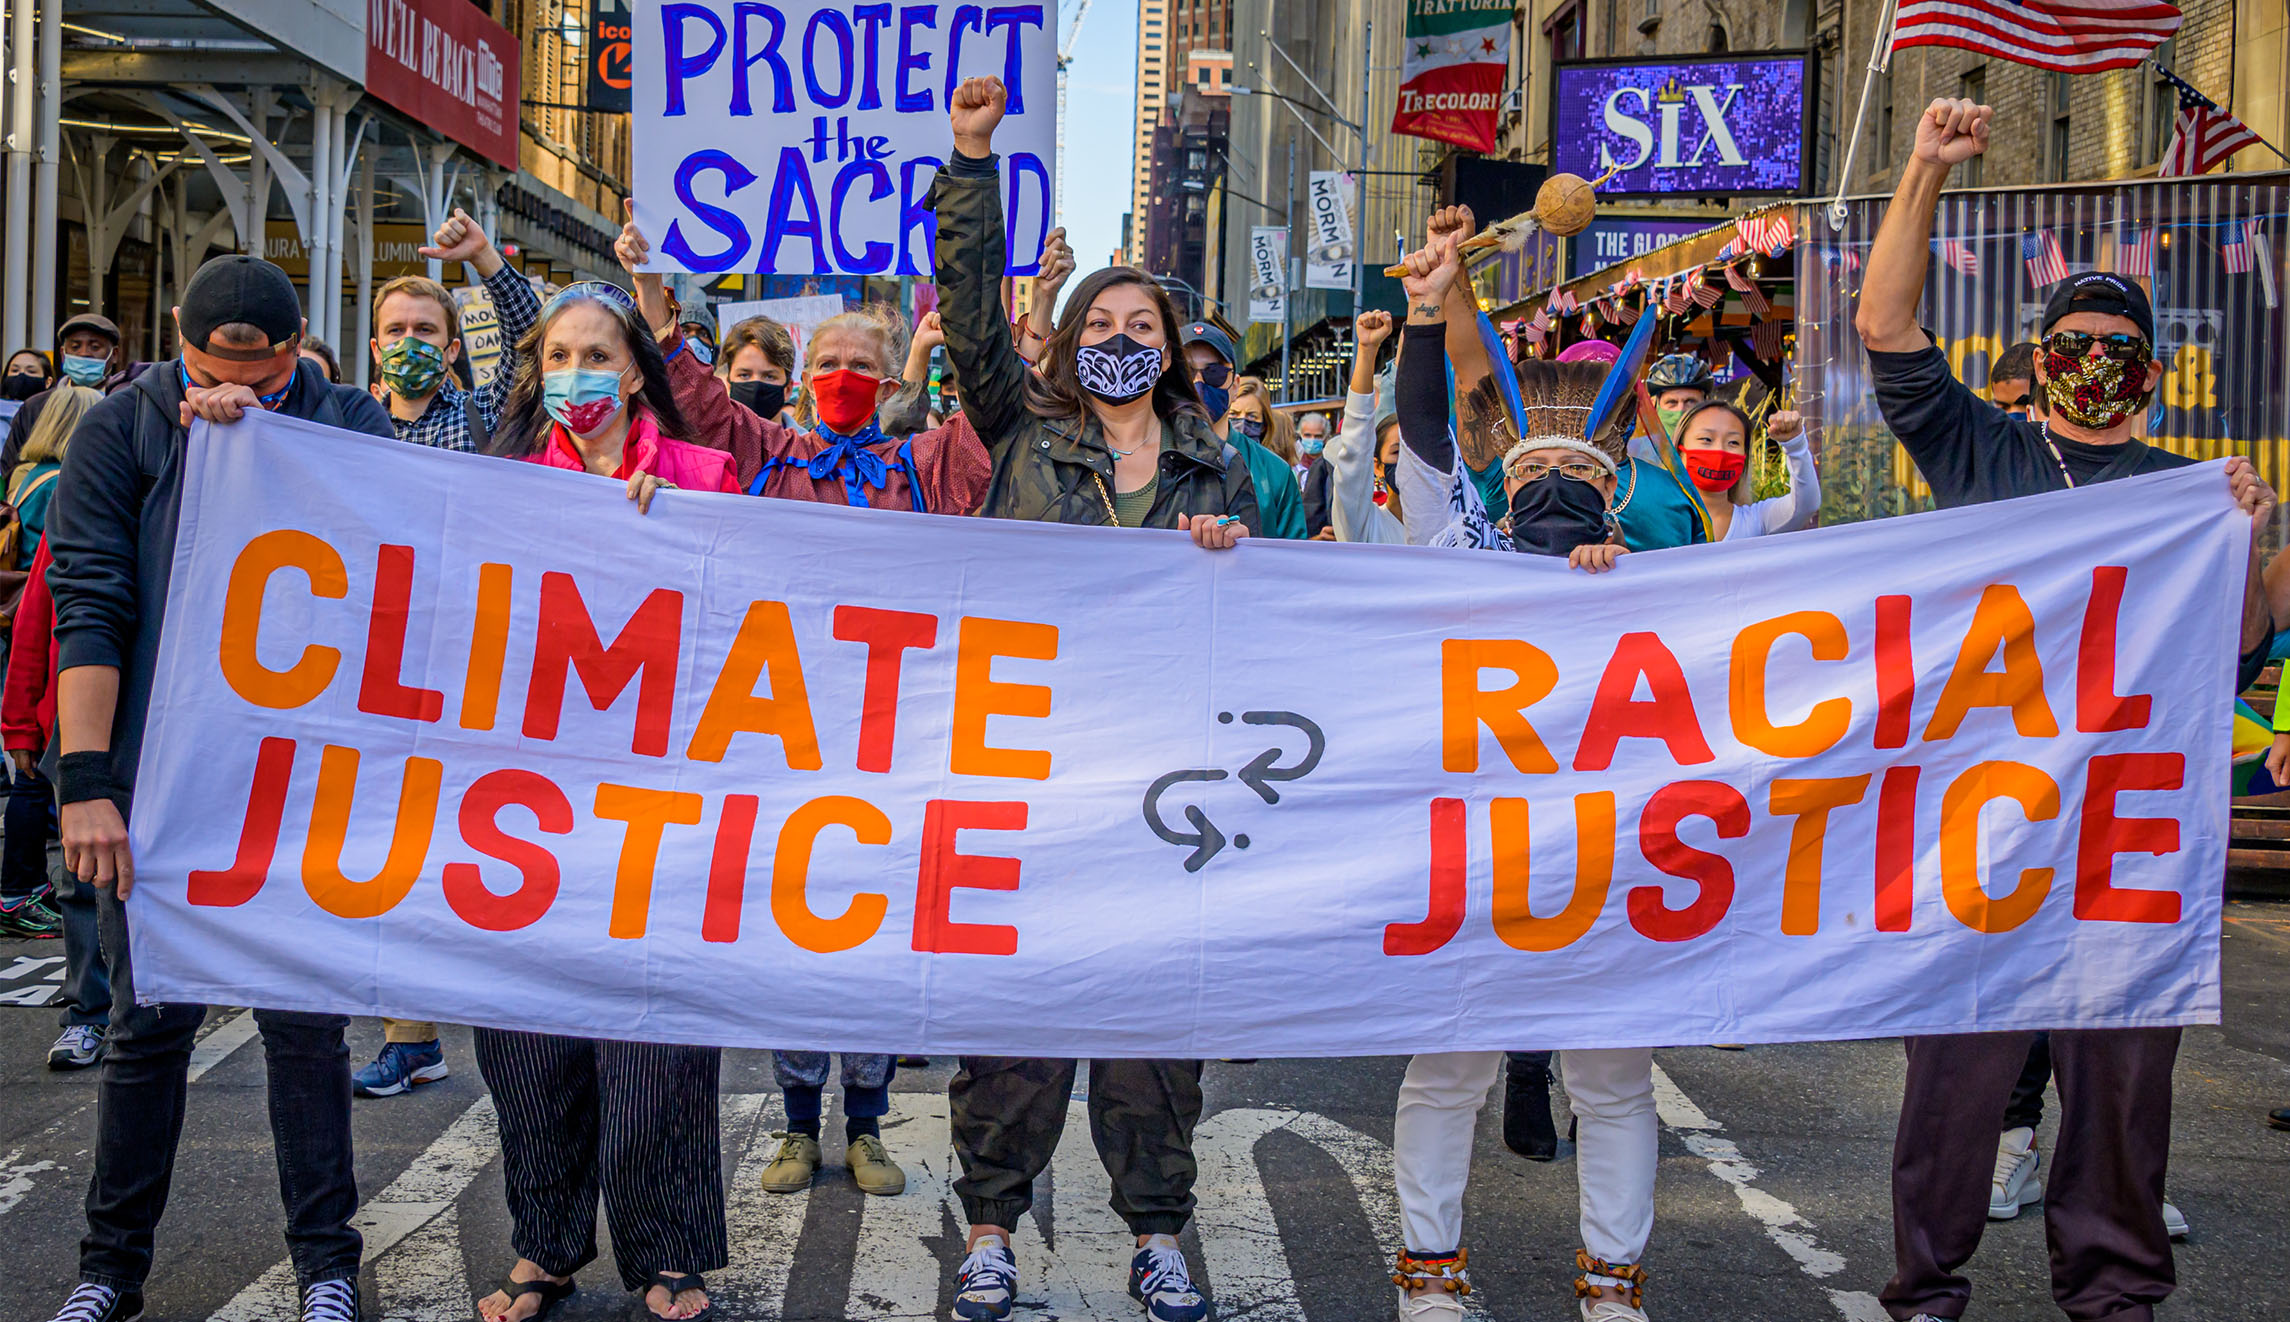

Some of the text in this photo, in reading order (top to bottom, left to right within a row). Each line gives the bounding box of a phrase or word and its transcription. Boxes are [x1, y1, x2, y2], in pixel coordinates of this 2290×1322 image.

[422, 18, 441, 85] BE
[442, 32, 476, 107] BACK
[661, 2, 1044, 116] PROTECT
[1400, 90, 1498, 114] TRECOLORI
[804, 116, 896, 164] the
[1601, 84, 1749, 170] SIX
[661, 146, 1050, 277] SACRD
[1595, 232, 1628, 256] THE
[2074, 275, 2104, 287] NATIVE
[219, 529, 1059, 781] CLIMATE
[1441, 565, 2152, 774] RACIAL
[187, 736, 1029, 956] JUSTICE
[1383, 752, 2185, 956] JUSTICE
